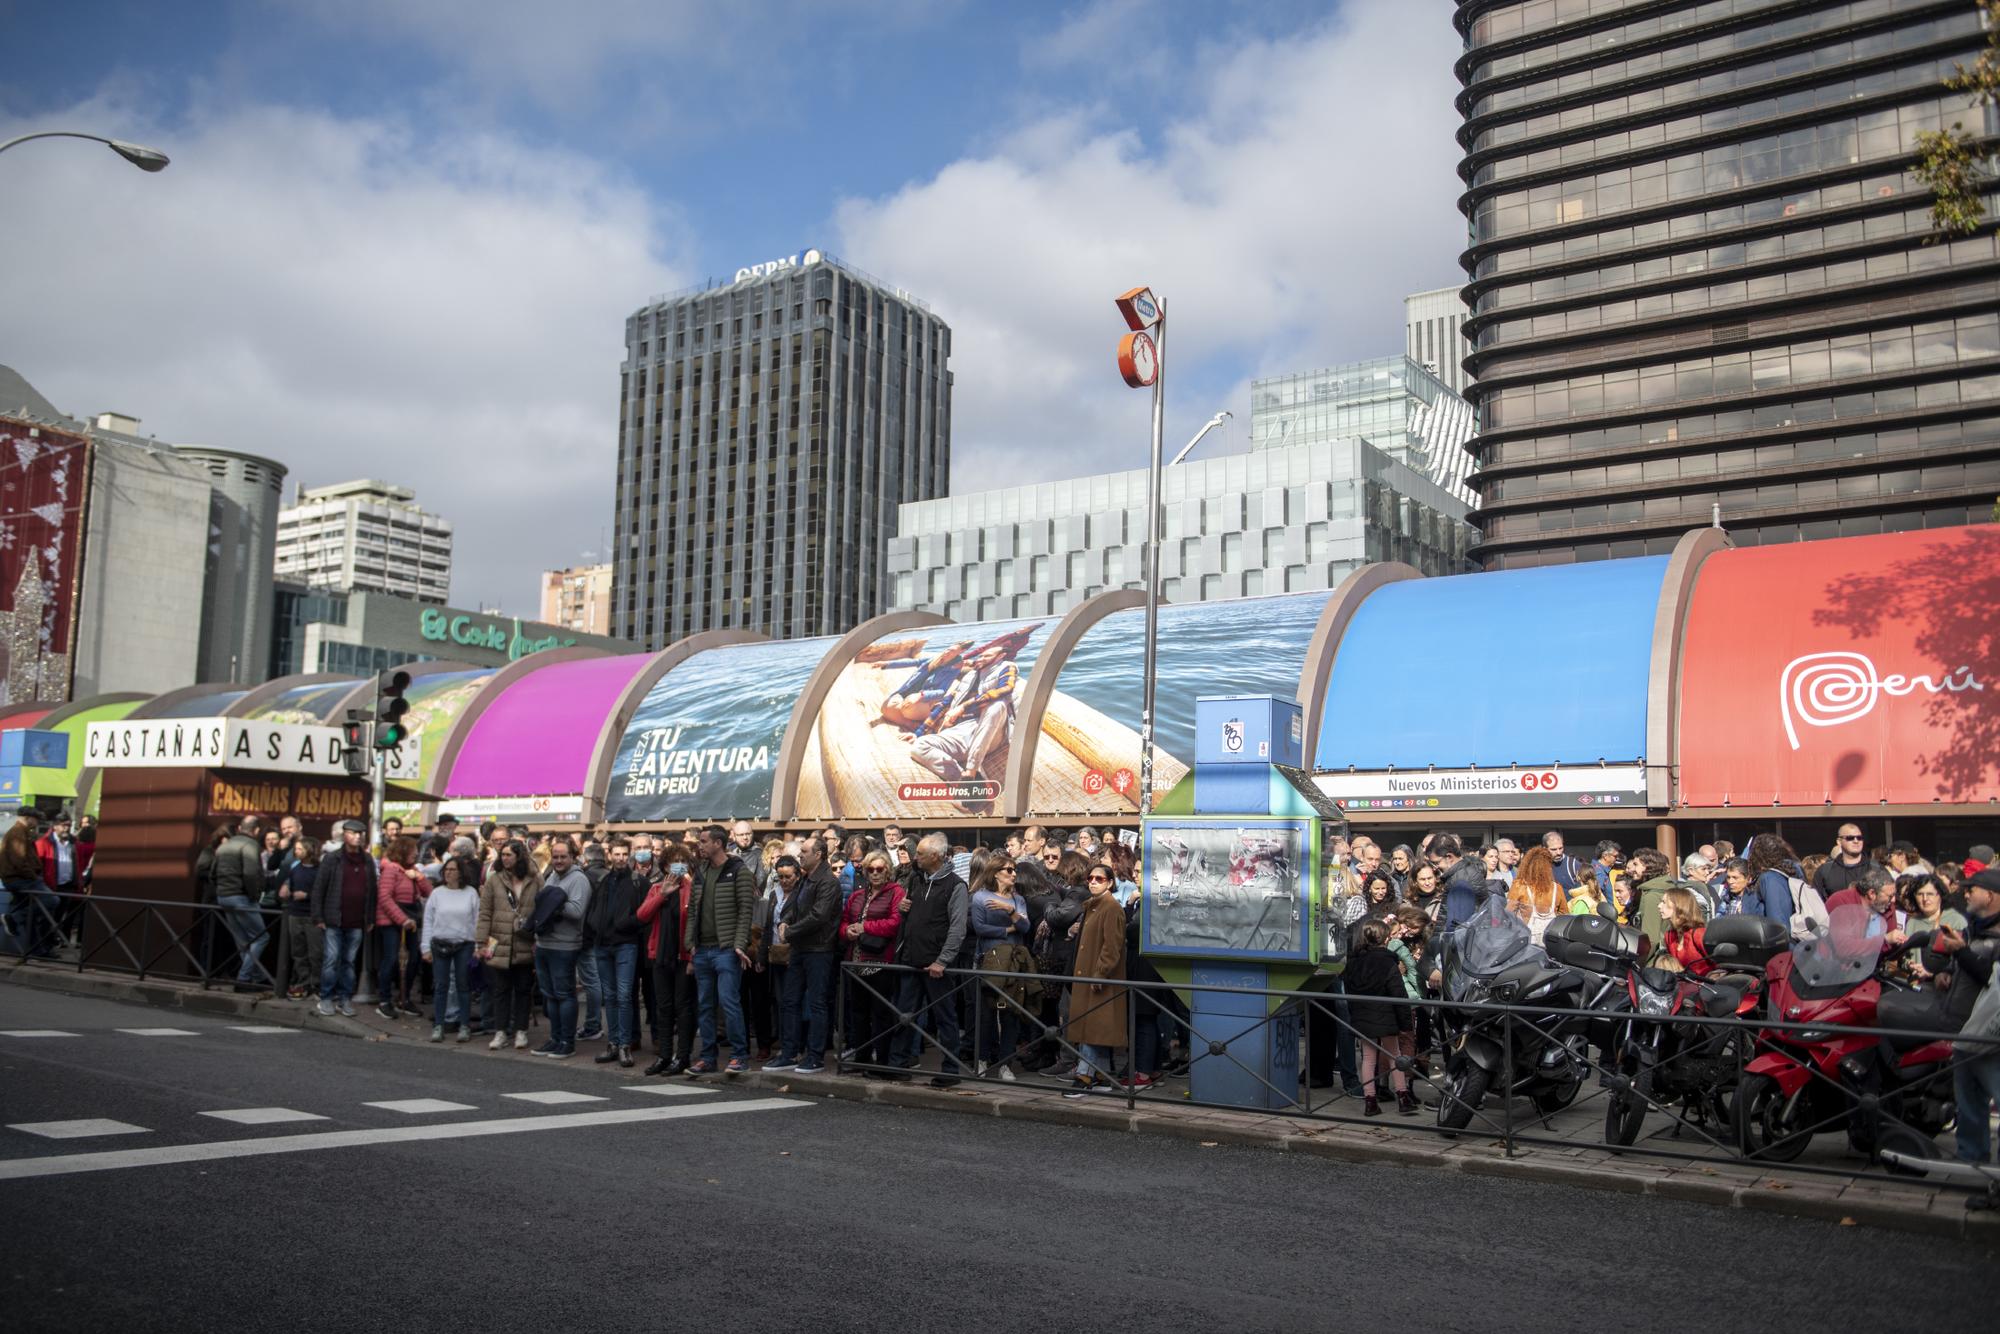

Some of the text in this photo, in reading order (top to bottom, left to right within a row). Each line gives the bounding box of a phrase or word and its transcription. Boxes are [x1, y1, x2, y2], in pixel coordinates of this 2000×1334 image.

[1137, 300, 1154, 316] Metro
[421, 608, 447, 641] El
[451, 615, 506, 651] Corte
[1781, 651, 1984, 750] Perú
[90, 724, 403, 769] CASTAÑAS ASADS
[650, 727, 681, 751] TU
[624, 731, 652, 796] EMPIEZA
[639, 746, 768, 776] AVENTURA
[635, 774, 700, 796] EN PERÚ
[912, 786, 994, 797] Islas Los Uros, Puno
[1388, 776, 1517, 792] Nuevos Ministerios
[213, 782, 364, 817] CASTAÑAS ASADAS
